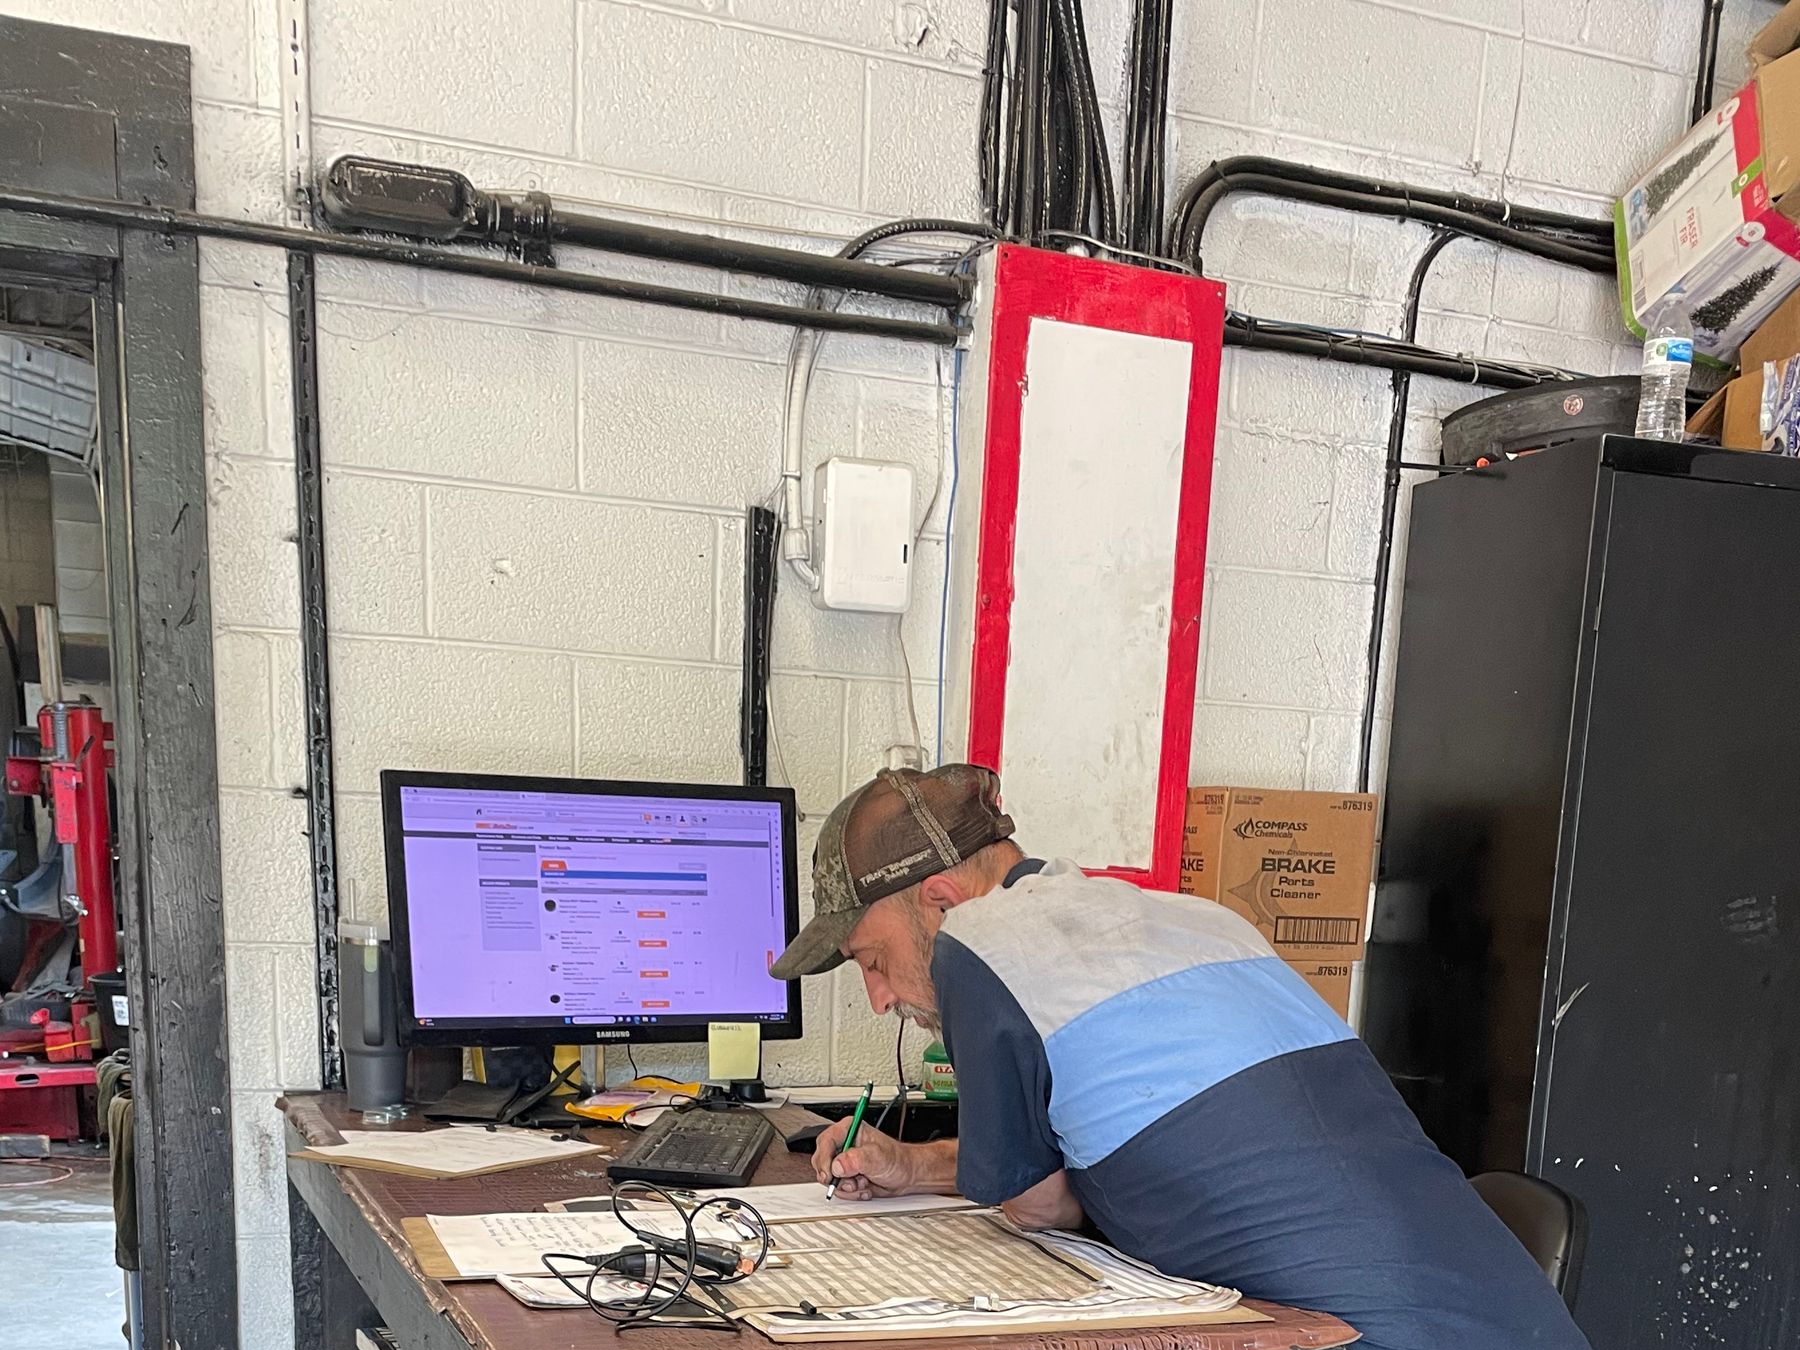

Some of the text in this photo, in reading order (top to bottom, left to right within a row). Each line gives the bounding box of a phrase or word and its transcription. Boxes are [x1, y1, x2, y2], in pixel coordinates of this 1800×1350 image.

[1687, 207, 1698, 248] FRASER
[1680, 226, 1688, 245] FIR
[1342, 800, 1373, 811] 876319
[1255, 821, 1308, 831] COMPASS
[1254, 830, 1293, 838] Chemicals
[1181, 859, 1204, 872] AKE
[1261, 857, 1335, 874] BRAKE
[1279, 876, 1315, 886] Parts
[1270, 888, 1321, 899] Cleaner
[1317, 966, 1348, 976] 876319
